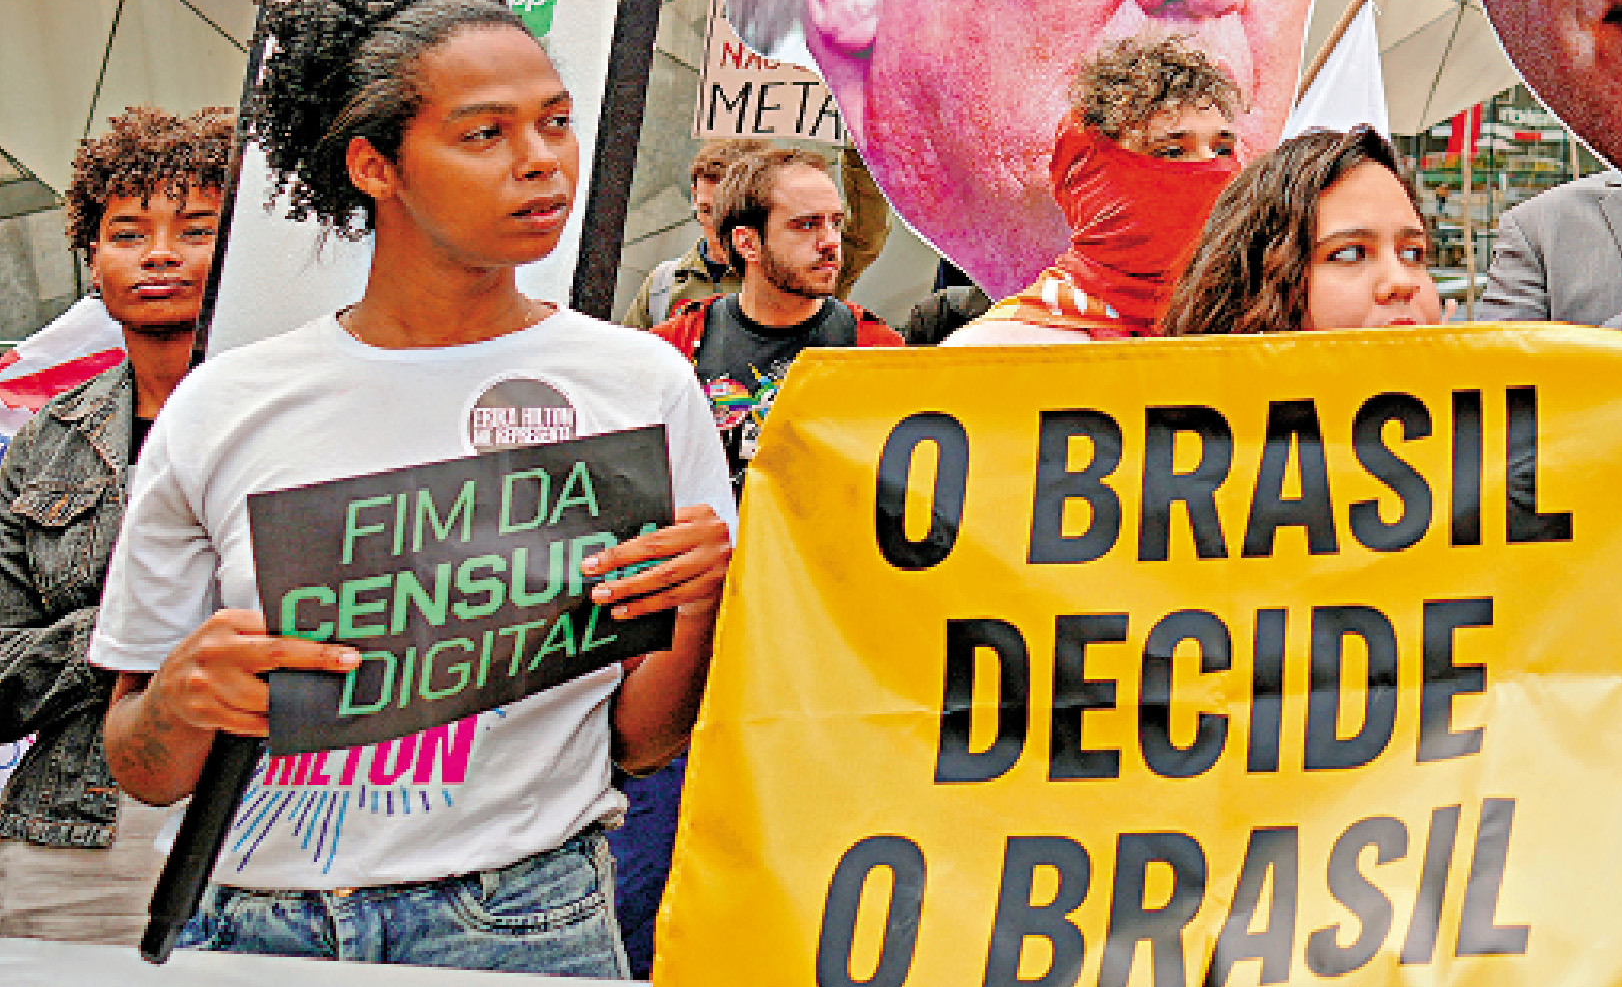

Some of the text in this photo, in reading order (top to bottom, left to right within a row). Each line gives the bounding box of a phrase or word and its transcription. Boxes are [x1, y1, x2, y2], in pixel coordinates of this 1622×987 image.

[707, 81, 841, 139] META
[340, 461, 599, 564] FIM DA
[875, 385, 1574, 571] O BRASIL
[339, 606, 618, 717] DIGITAL
[934, 597, 1495, 785] DECIDE
[816, 798, 1530, 987] O BRASIL
